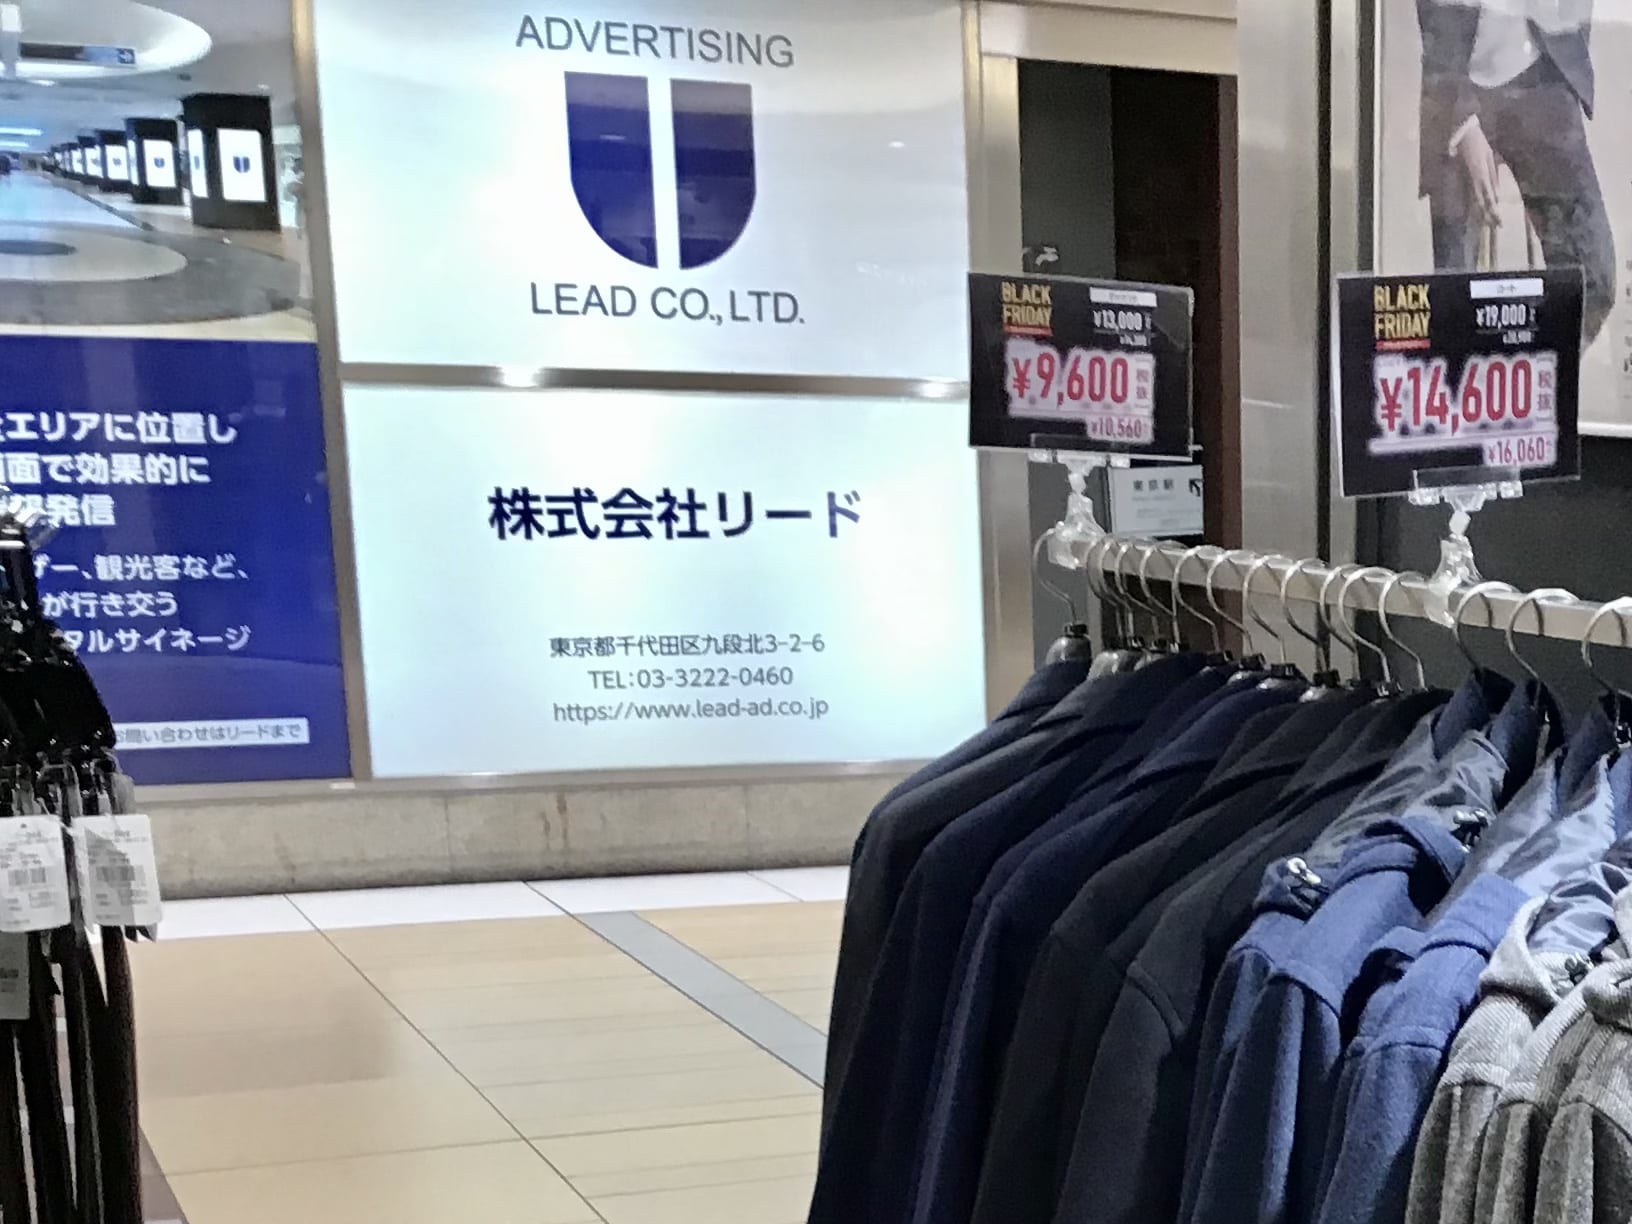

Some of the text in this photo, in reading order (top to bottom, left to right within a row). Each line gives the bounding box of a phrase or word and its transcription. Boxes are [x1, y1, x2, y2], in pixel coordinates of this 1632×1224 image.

[515, 14, 795, 68] ADVERTISING
[530, 281, 637, 318] LEAD
[1001, 281, 1052, 304] BLACK
[1373, 283, 1431, 311] BLACK
[1002, 304, 1052, 327] FRIDAY
[1374, 311, 1431, 339] FRIDAY
[1012, 352, 1129, 409] ¥9,600
[1379, 359, 1532, 437] ¥14,600
[0, 410, 238, 445] エリアに位置し
[0, 452, 212, 486] 面で効果的に
[487, 485, 862, 541] 株式会社リード
[42, 591, 178, 619] が行き交う
[549, 633, 826, 658] 東京都千代田区九段北3-2-6
[587, 665, 795, 691] TEL:03-3222-0460
[552, 697, 829, 726] https://www.lead-ad.co.jp
